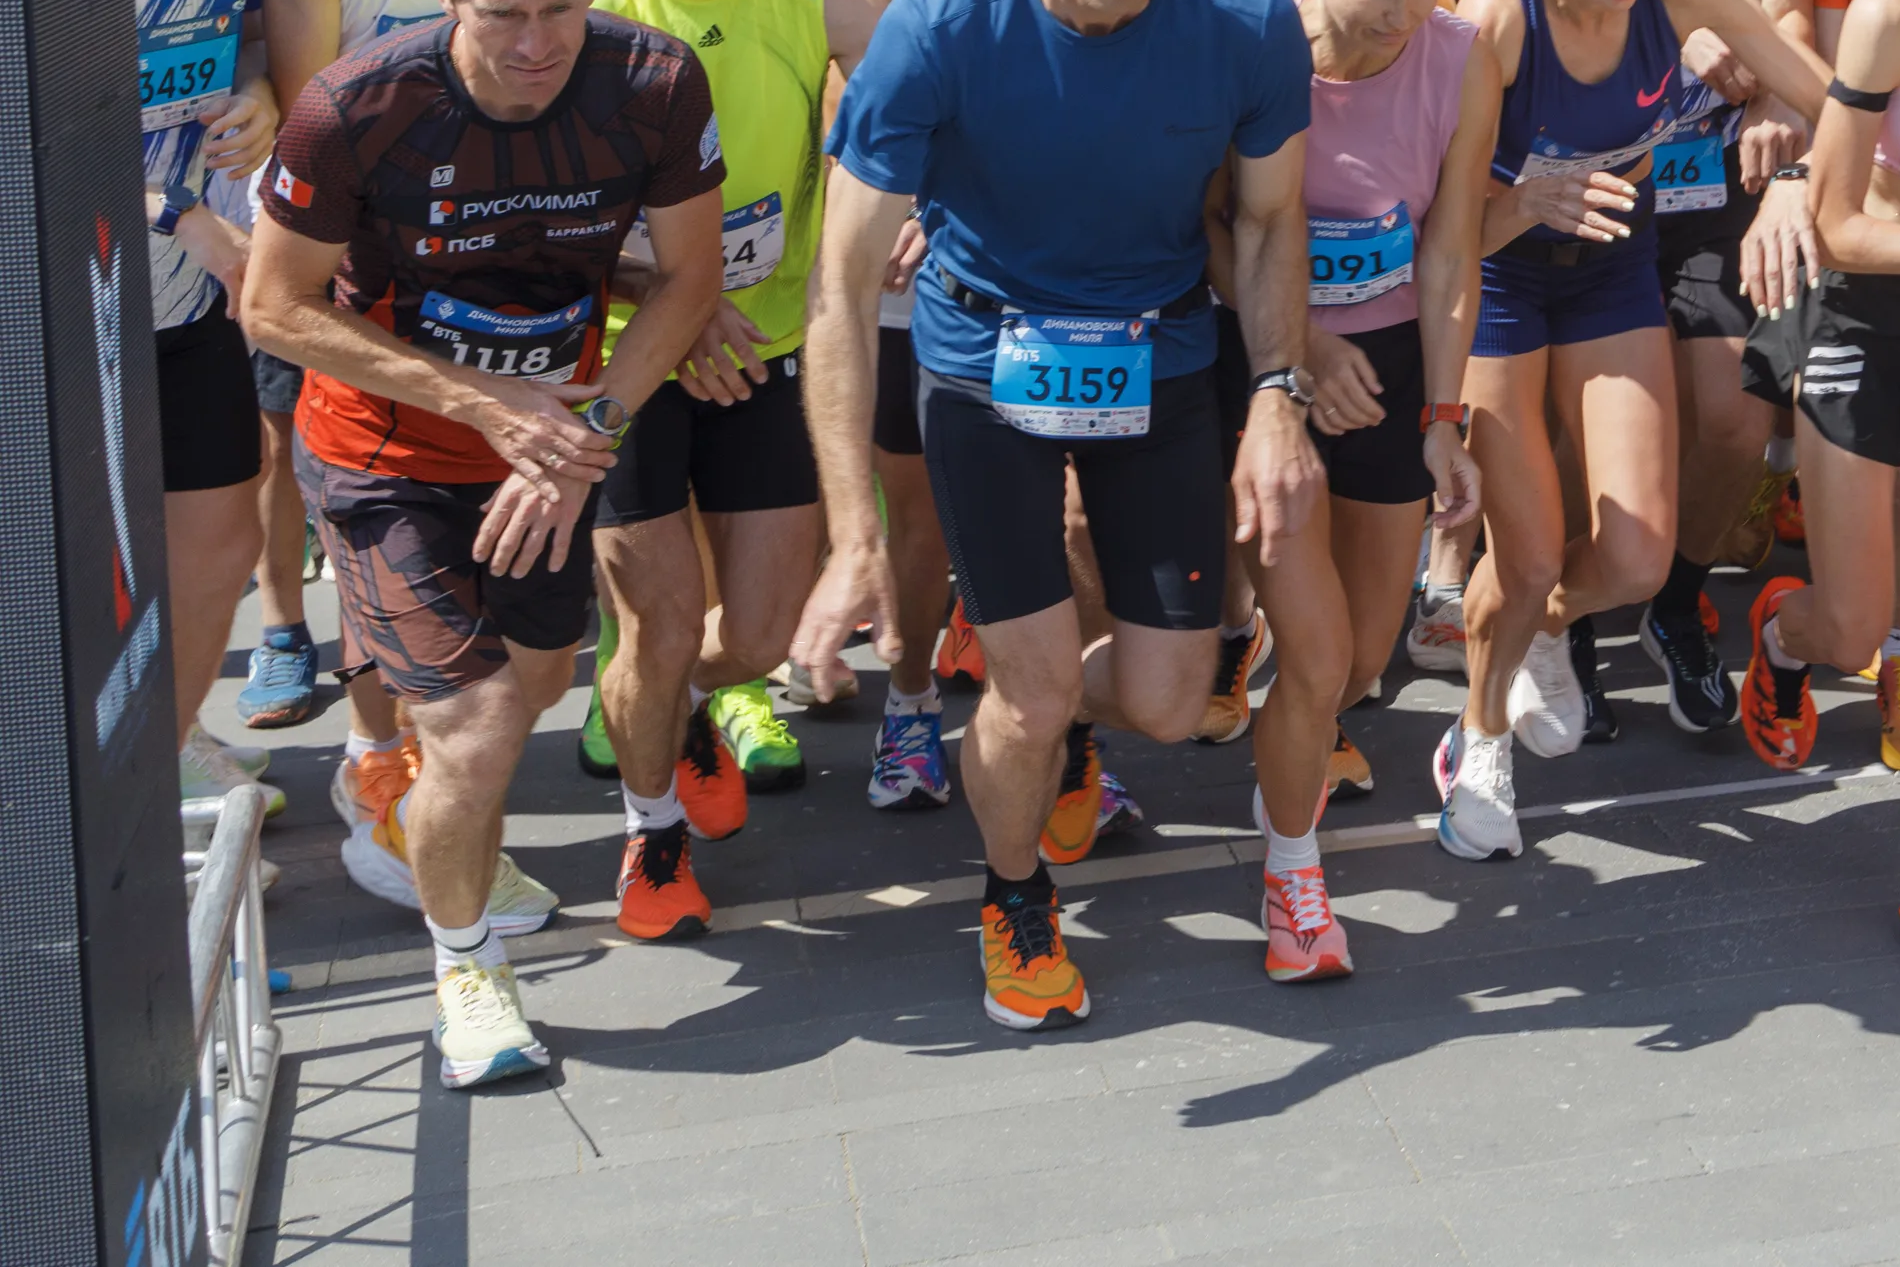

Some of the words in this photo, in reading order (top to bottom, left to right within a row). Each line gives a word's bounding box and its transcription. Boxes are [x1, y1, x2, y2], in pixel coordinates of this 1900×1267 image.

[139, 58, 216, 105] 3439
[462, 189, 602, 220] РУСКЛИМАТ
[546, 219, 617, 238] БАРРАКУДА
[448, 233, 496, 253] ПСБ
[467, 310, 561, 326] ДИНАМОВСКАЯ
[1041, 319, 1125, 332] ДИНАМОВСКАЯ
[432, 325, 463, 342] ВТБ
[494, 326, 533, 335] МИЛЯ
[1068, 333, 1104, 343] МИЛЯ
[452, 342, 552, 375] 1118
[1012, 348, 1040, 362] ВТБ
[1026, 365, 1129, 405] 3159
